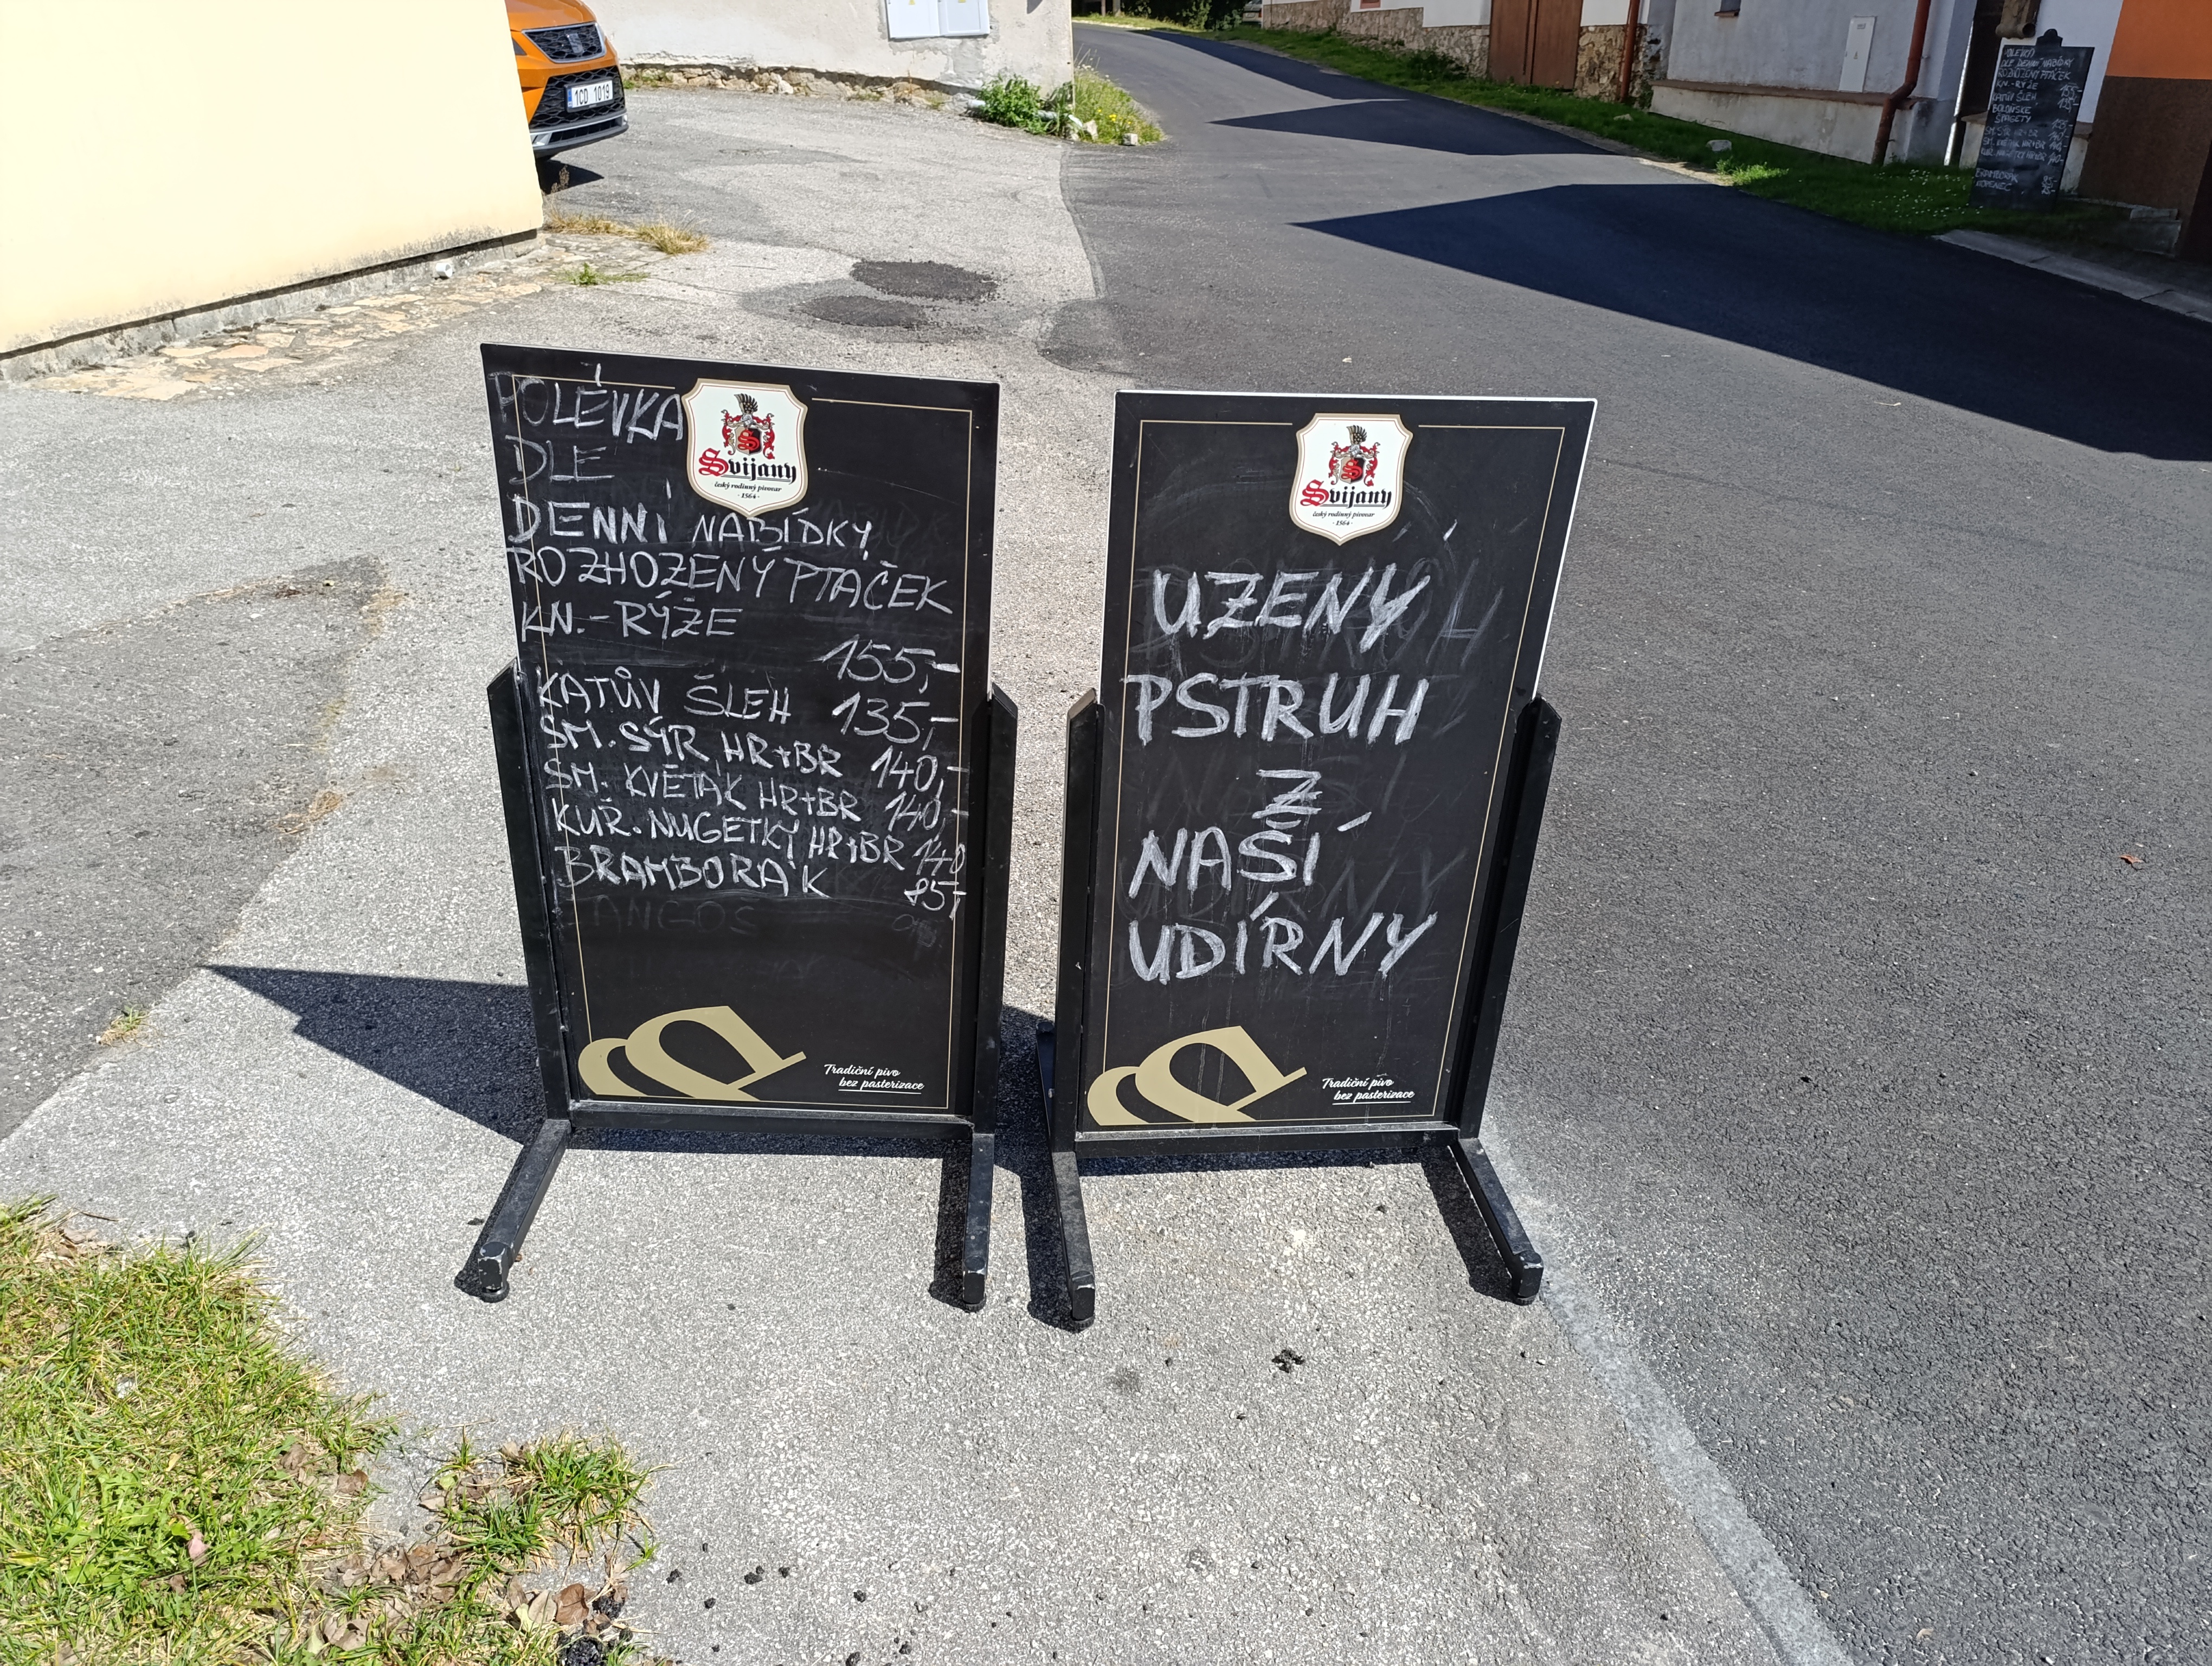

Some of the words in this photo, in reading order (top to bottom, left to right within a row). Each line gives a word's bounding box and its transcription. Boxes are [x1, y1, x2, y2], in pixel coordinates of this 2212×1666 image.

[575, 88, 589, 106] 1CD
[593, 84, 609, 101] 1019
[2016, 90, 2037, 102] ŠLEH
[1994, 112, 2031, 123] ŠPAGETY
[505, 435, 615, 485] DLE
[698, 448, 797, 484] Svijany
[714, 482, 730, 490] český
[731, 483, 756, 491] rodinný
[1300, 479, 1392, 509] Svijany
[1312, 511, 1327, 519] český
[1328, 511, 1352, 519] rodinný
[691, 508, 872, 555] NABÍDKY
[536, 664, 660, 713] KATŮV
[684, 674, 791, 724] ŠLEH
[1123, 672, 1430, 745] PSTRUH
[619, 715, 710, 761] SÝR
[648, 806, 800, 858] NUGETKY
[1128, 892, 1438, 985] UDÍRNY
[824, 1063, 874, 1075] Tradiční
[874, 1067, 901, 1079] pivo
[839, 1077, 858, 1087] bez
[860, 1079, 925, 1091] pasterizace
[1322, 1077, 1371, 1090] Tradiční
[1368, 1078, 1394, 1091] pivo
[1333, 1090, 1353, 1100] bez
[1353, 1090, 1416, 1103] pasterizace
